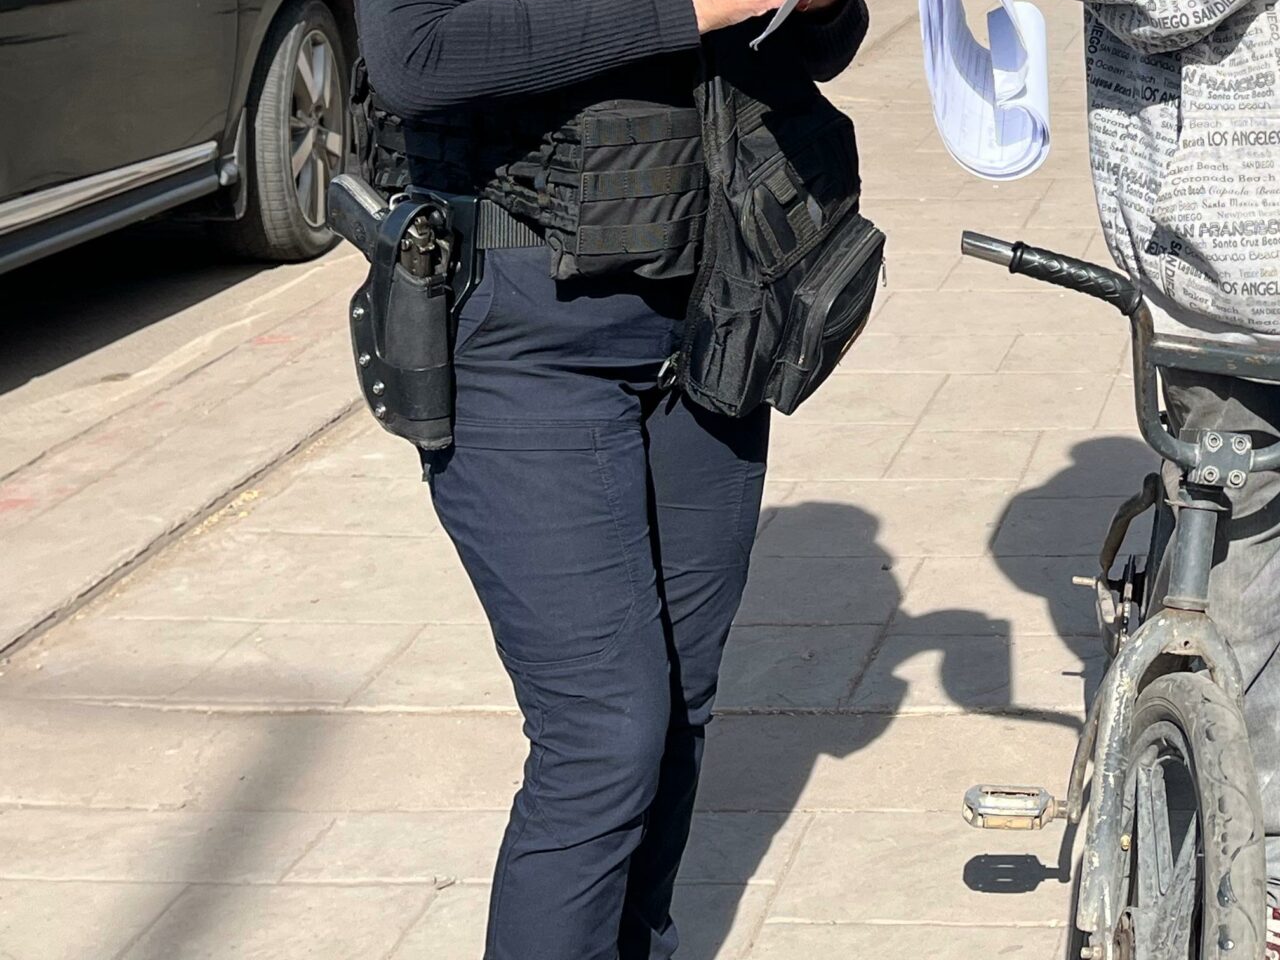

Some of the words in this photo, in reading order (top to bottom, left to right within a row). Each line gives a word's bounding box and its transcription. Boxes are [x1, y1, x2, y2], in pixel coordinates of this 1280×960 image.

[1151, 12, 1190, 30] DIEGO
[1193, 8, 1219, 25] SAN
[1265, 2, 1280, 41] DIEGO
[1095, 59, 1126, 76] Ocean
[1198, 70, 1276, 92] FRANCISCO
[1141, 85, 1160, 102] LOS
[1207, 90, 1231, 101] Santa
[1233, 91, 1250, 101] Cruz
[1251, 88, 1275, 99] Beach
[1189, 100, 1236, 112] Redondo
[1238, 101, 1272, 111] Beach
[1189, 121, 1222, 130] Beach
[1208, 130, 1229, 147] LOS
[1196, 161, 1229, 172] Beach
[1241, 161, 1254, 169] SAN
[1255, 160, 1275, 170] DIEGO
[1171, 174, 1235, 186] Coronado
[1238, 173, 1276, 183] Beach
[1173, 186, 1187, 197] Cruz
[1208, 185, 1249, 198] Capitola
[1202, 198, 1226, 209] Santa
[1229, 197, 1259, 208] Monica
[1177, 212, 1203, 222] DIEGO
[1212, 238, 1238, 249] Santa
[1240, 237, 1260, 248] Cruz
[1165, 240, 1182, 268] SAN
[1182, 287, 1209, 304] Baker
